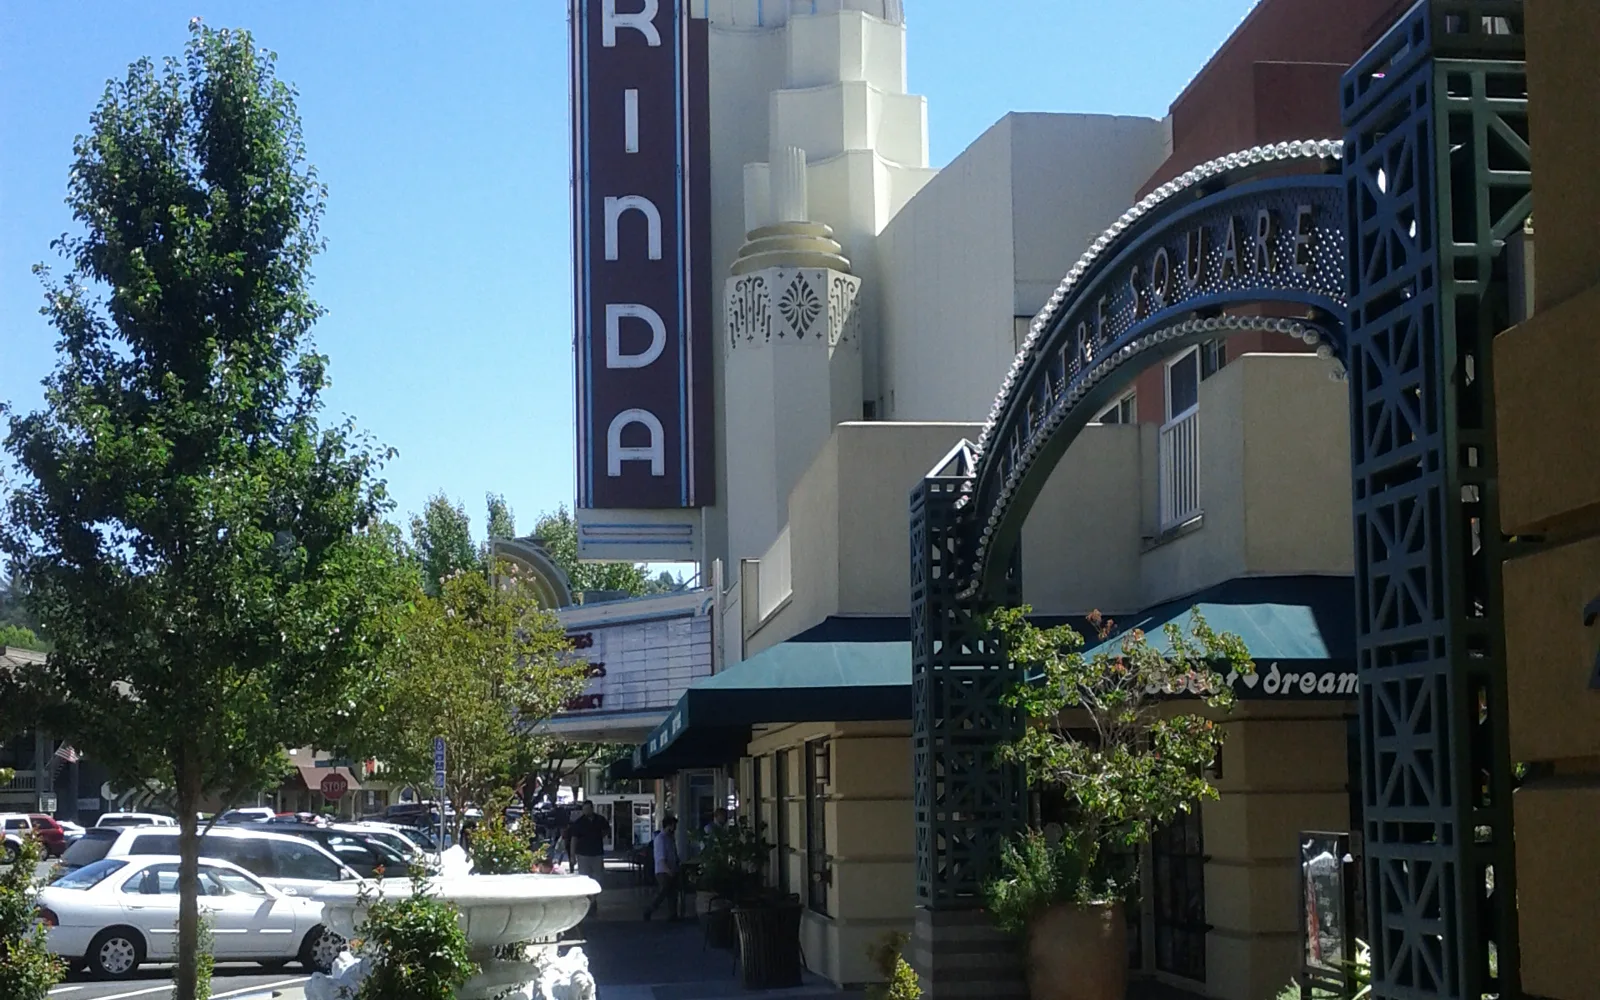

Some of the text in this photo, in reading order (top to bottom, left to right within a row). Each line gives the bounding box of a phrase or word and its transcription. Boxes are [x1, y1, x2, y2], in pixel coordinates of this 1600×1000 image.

[997, 204, 1313, 489] THEATRE SQUARE
[322, 781, 347, 793] STOP
